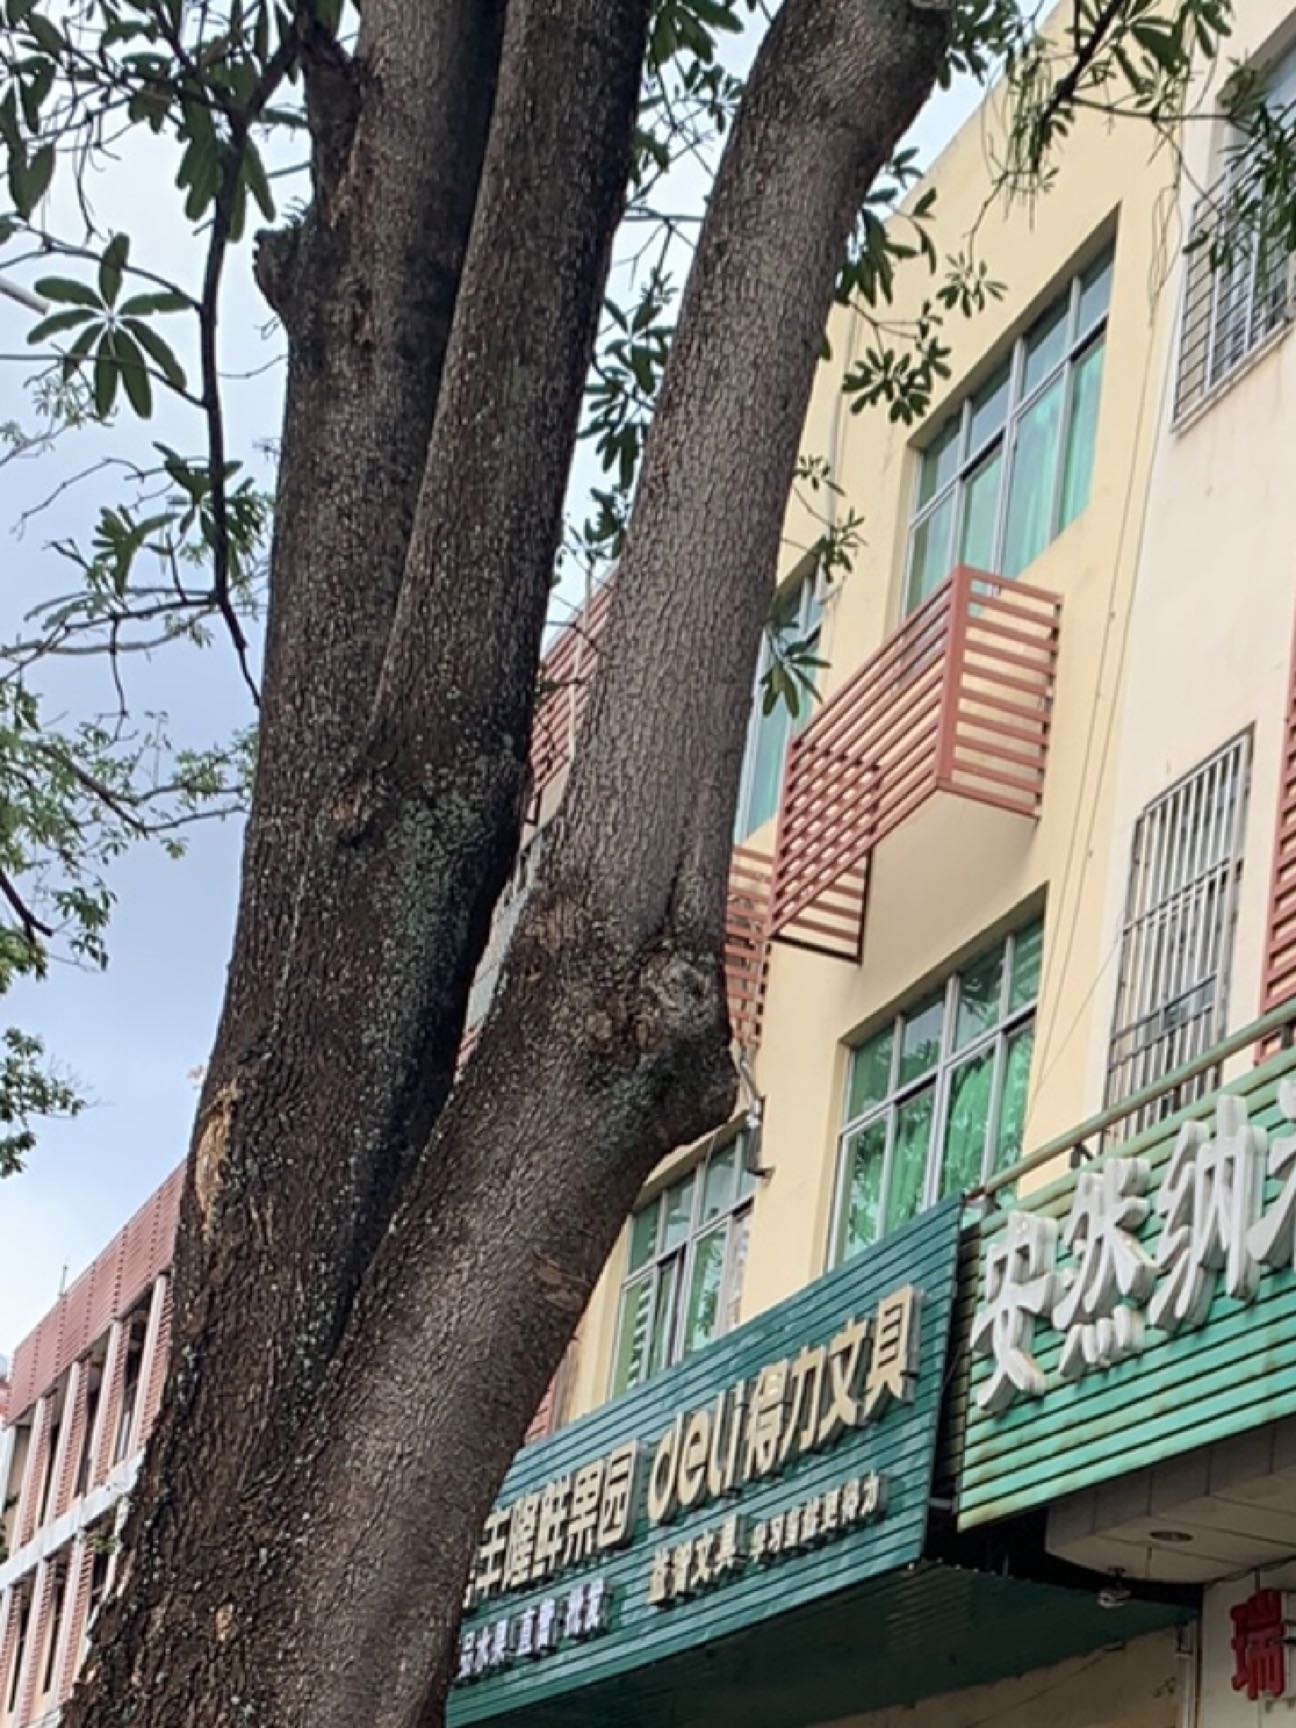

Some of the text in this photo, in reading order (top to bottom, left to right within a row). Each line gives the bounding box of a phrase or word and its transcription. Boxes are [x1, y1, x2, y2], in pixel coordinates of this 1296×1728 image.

[463, 1283, 915, 1609] 丰隆鲜果园 deli 得力文具
